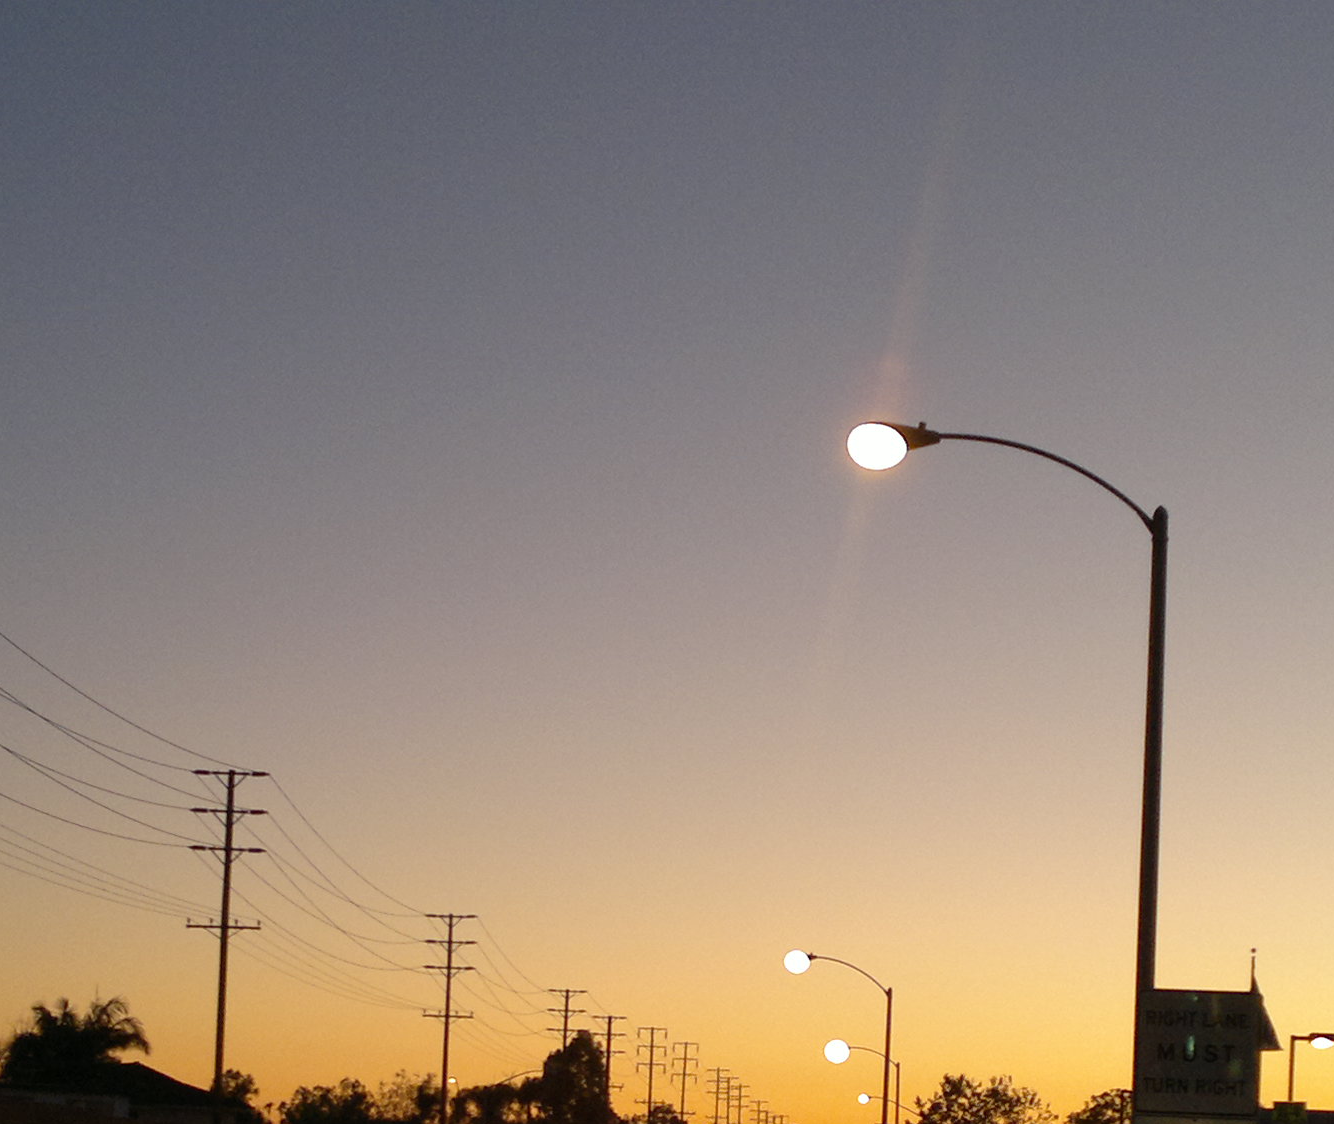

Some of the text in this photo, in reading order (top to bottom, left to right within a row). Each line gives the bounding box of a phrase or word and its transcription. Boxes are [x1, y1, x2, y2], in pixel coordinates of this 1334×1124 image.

[1146, 1010, 1250, 1029] RIGHT LANE
[1157, 1043, 1235, 1063] MUST
[1144, 1076, 1246, 1096] TURN RIGHT
